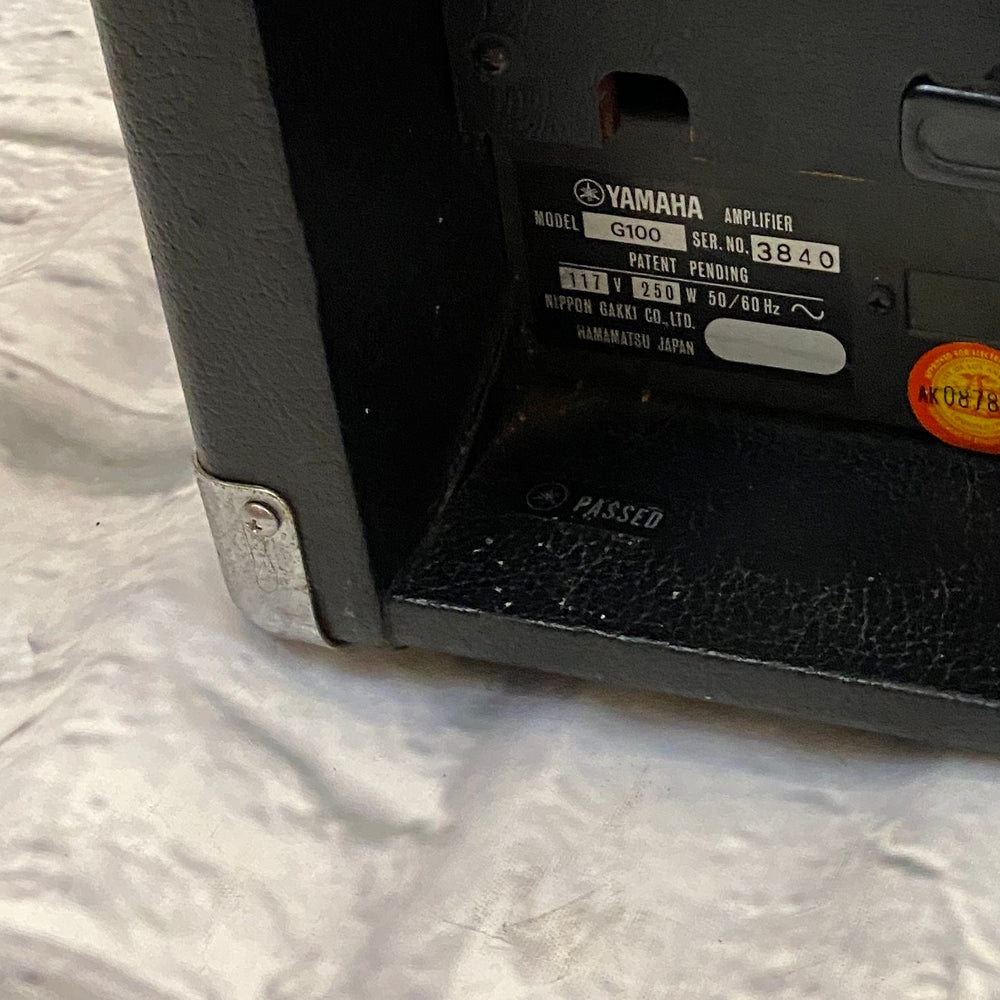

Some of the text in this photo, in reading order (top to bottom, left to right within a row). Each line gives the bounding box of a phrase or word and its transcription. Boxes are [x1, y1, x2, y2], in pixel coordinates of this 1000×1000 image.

[606, 184, 793, 232] YAMAHA AMPLIFIER
[534, 210, 834, 269] MODEL G100 SER. NO. 3840
[629, 252, 749, 284] PATENT PENDING
[569, 272, 600, 290] 117
[613, 277, 621, 293] V
[641, 281, 674, 301] 250
[686, 287, 697, 303] W
[544, 293, 593, 314] NIPPON
[600, 301, 637, 320] GAKKI
[576, 324, 695, 356] HAMAMATSU JAPAN
[573, 496, 664, 529] PASSED
